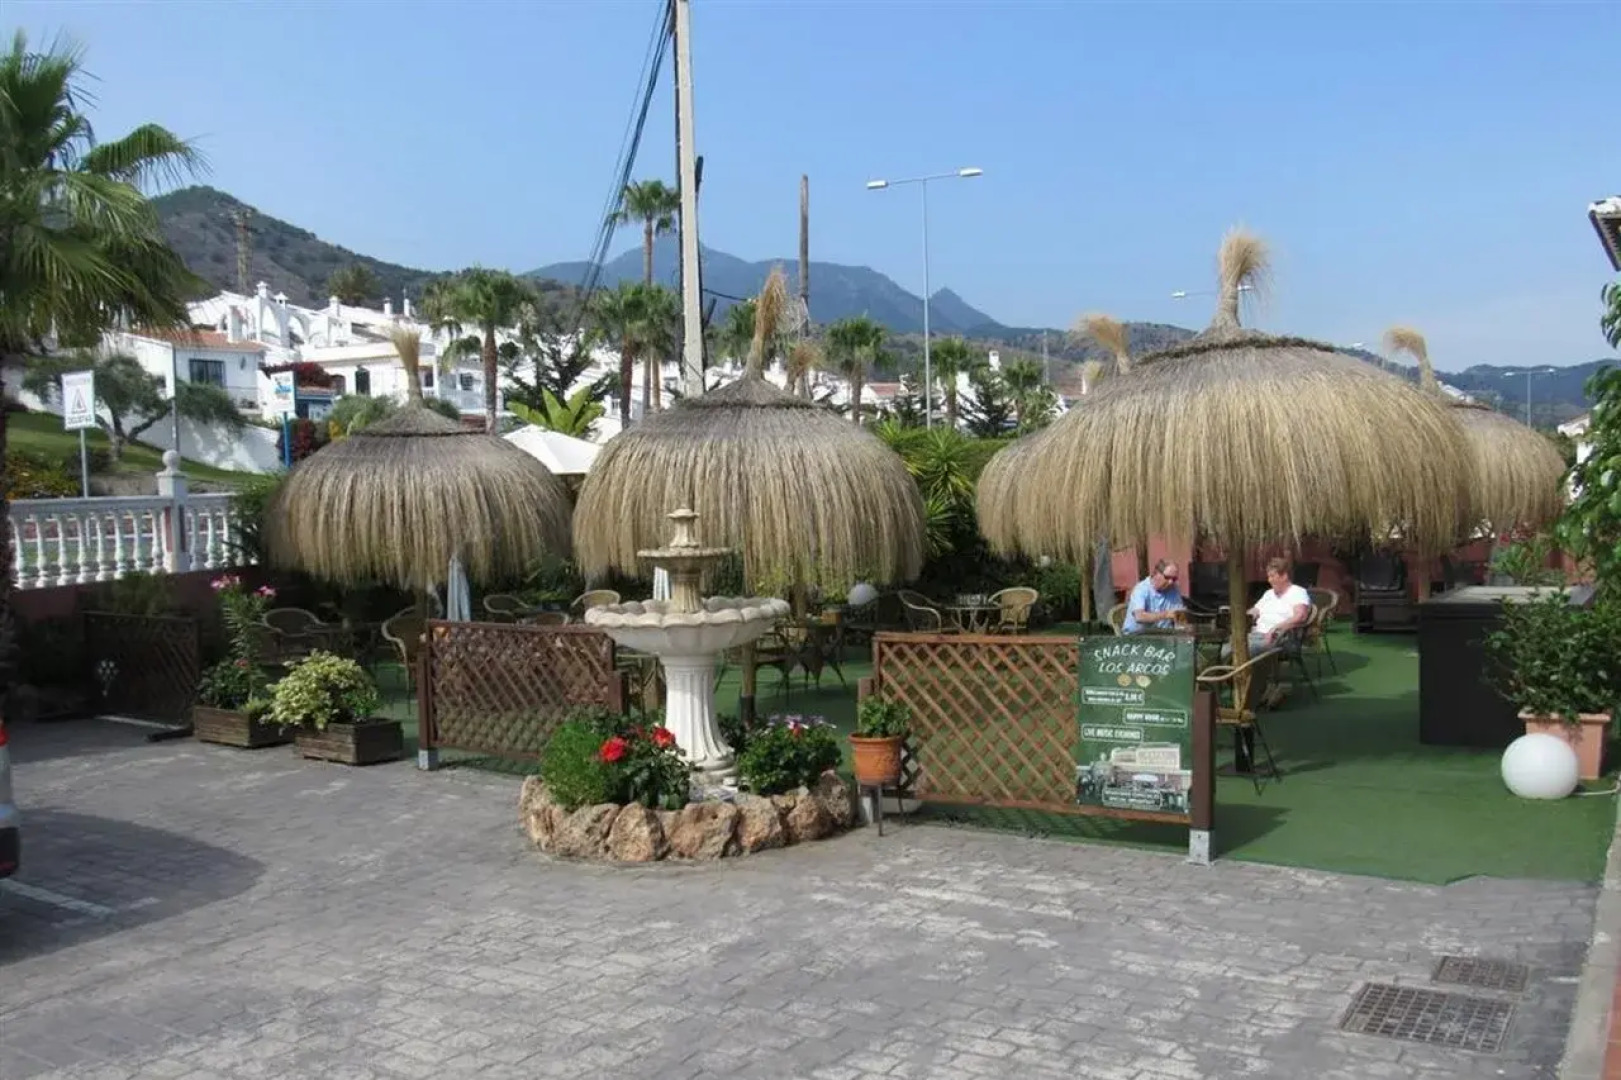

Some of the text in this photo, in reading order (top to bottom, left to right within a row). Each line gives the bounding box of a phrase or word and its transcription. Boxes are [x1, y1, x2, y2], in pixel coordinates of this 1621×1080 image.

[1093, 643, 1176, 662] SNACK BAR
[1098, 662, 1171, 676] LOS ARCOS
